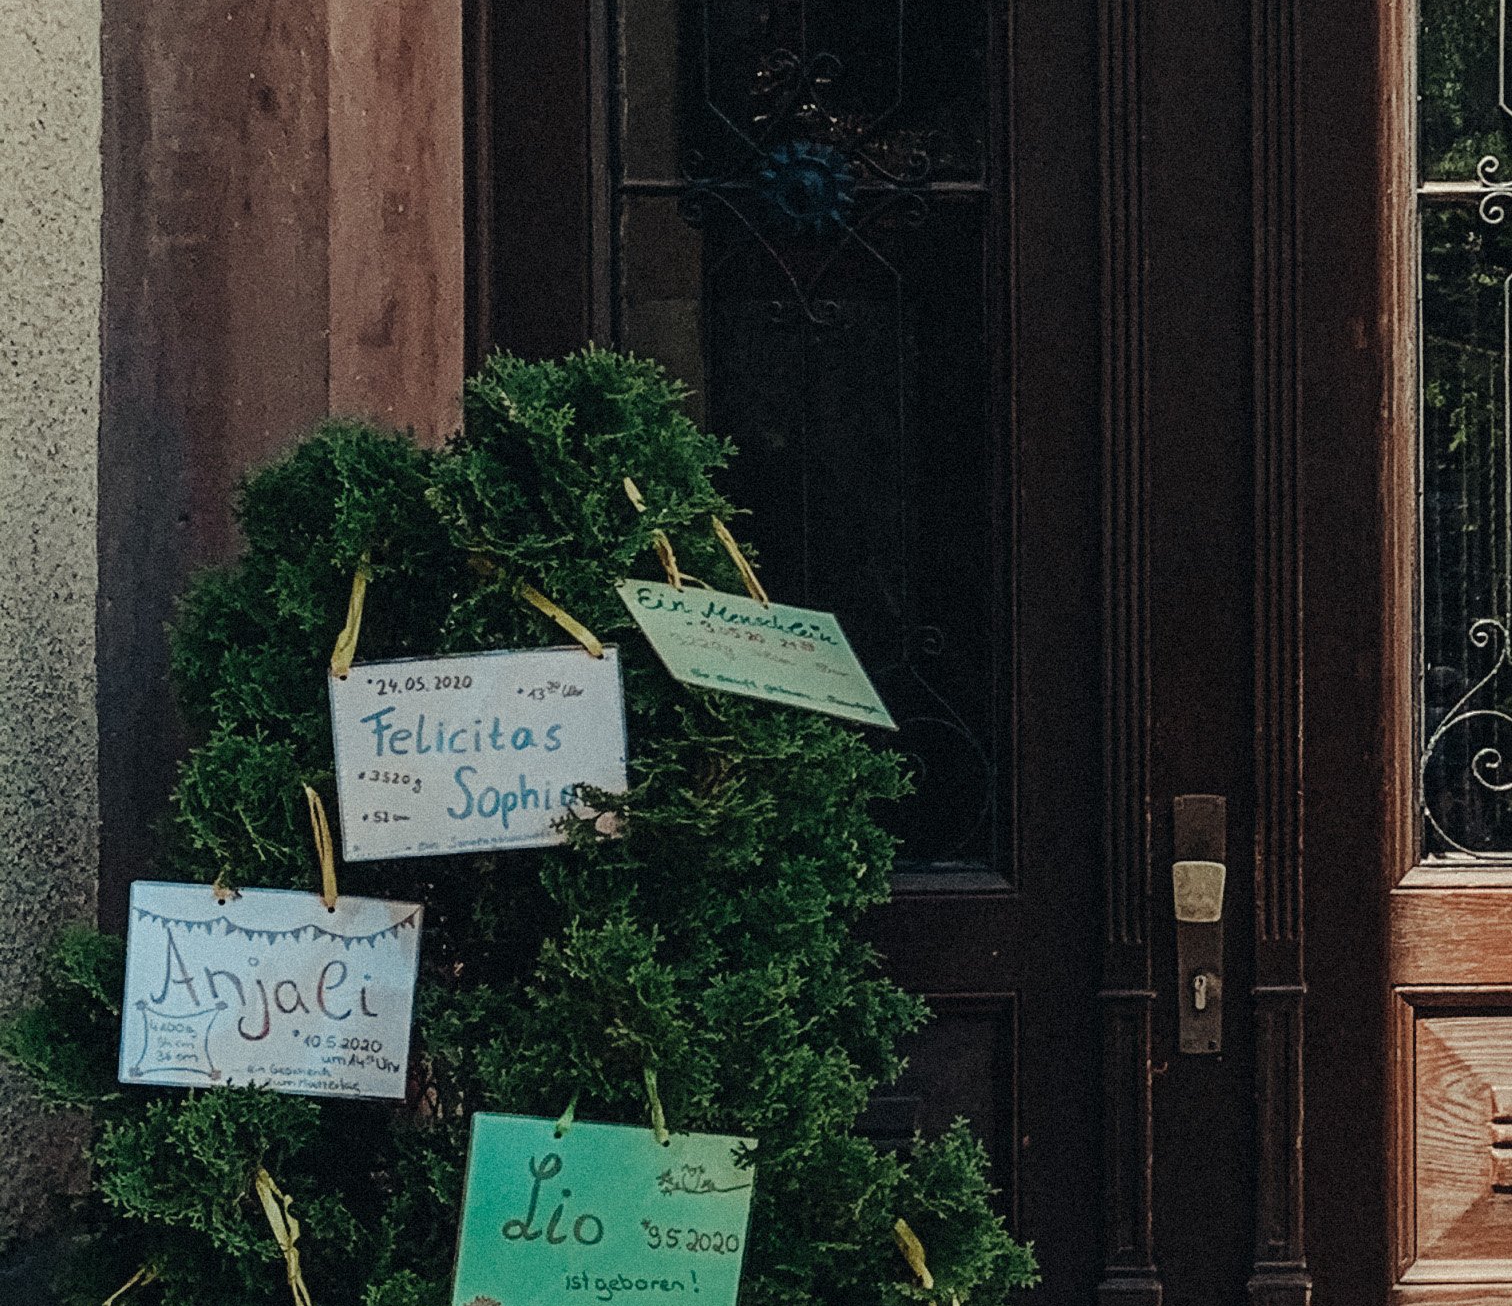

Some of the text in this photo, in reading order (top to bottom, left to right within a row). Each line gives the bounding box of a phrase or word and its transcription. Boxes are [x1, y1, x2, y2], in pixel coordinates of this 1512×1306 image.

[636, 587, 692, 614] Ein
[377, 675, 473, 696] 24.05.2020
[360, 706, 562, 757] Felicitas
[150, 927, 378, 1042] Anjali
[501, 1151, 605, 1246] Lio
[565, 1273, 589, 1292] ist
